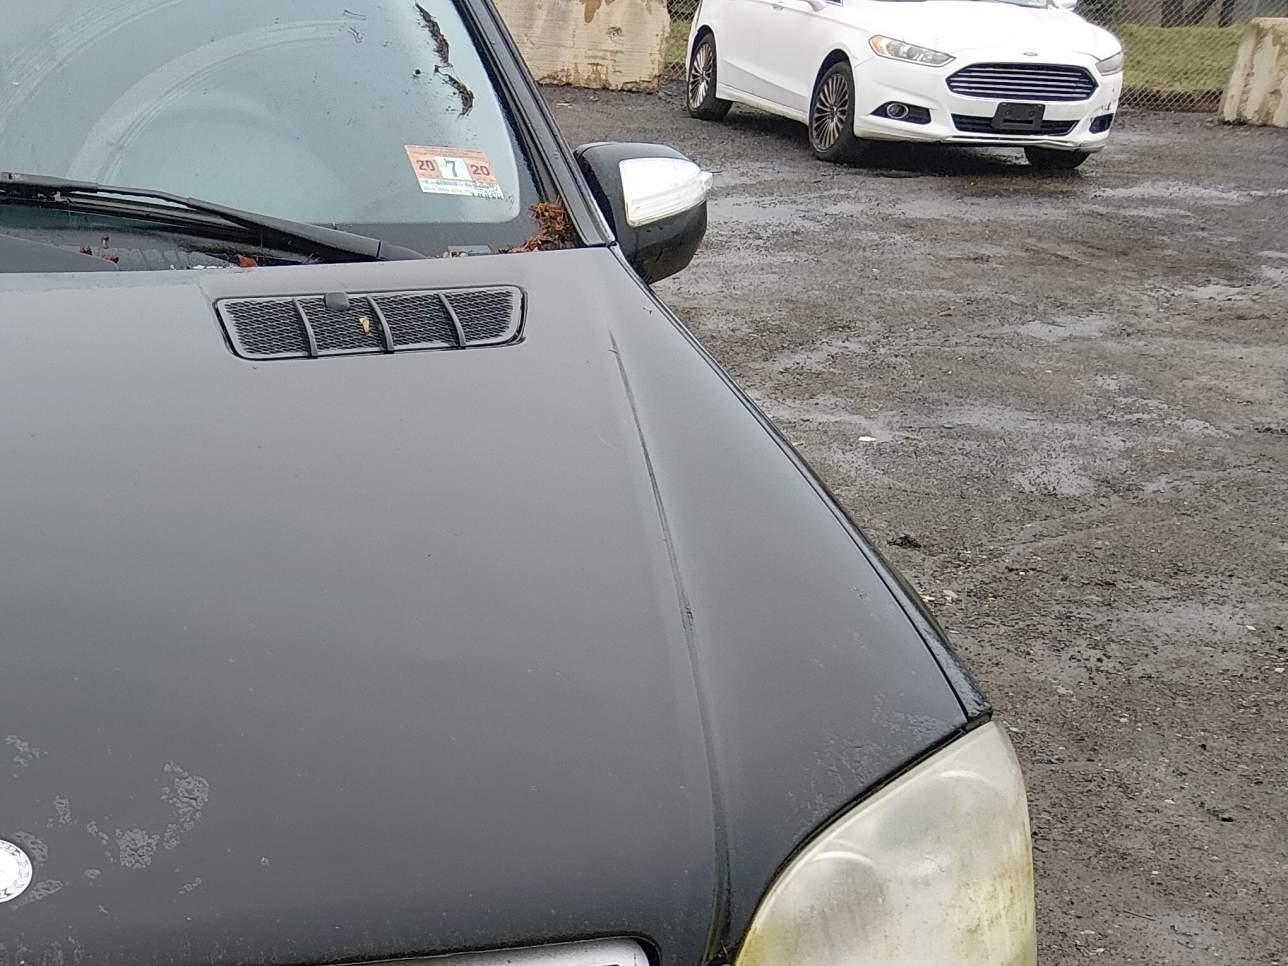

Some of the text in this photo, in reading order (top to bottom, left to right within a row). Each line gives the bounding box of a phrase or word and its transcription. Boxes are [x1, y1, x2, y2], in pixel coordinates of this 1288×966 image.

[416, 159, 491, 178] 20 7 20
